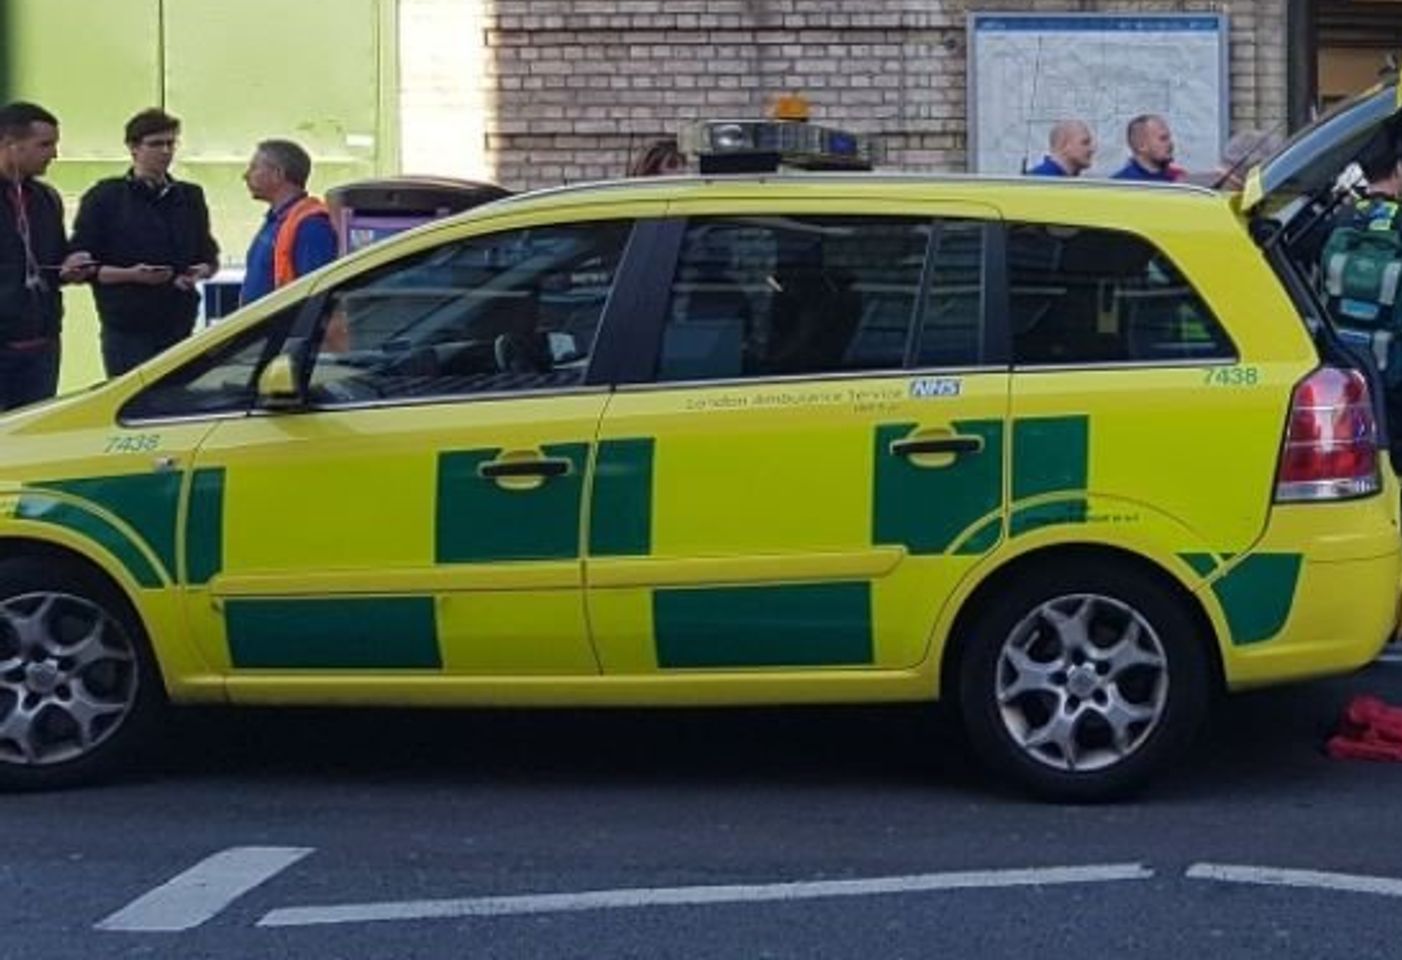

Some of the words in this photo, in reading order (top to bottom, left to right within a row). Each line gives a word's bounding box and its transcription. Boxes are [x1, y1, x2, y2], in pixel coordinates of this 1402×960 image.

[1202, 367, 1258, 386] 7438
[911, 379, 960, 397] NHS
[103, 434, 161, 454] 7438
